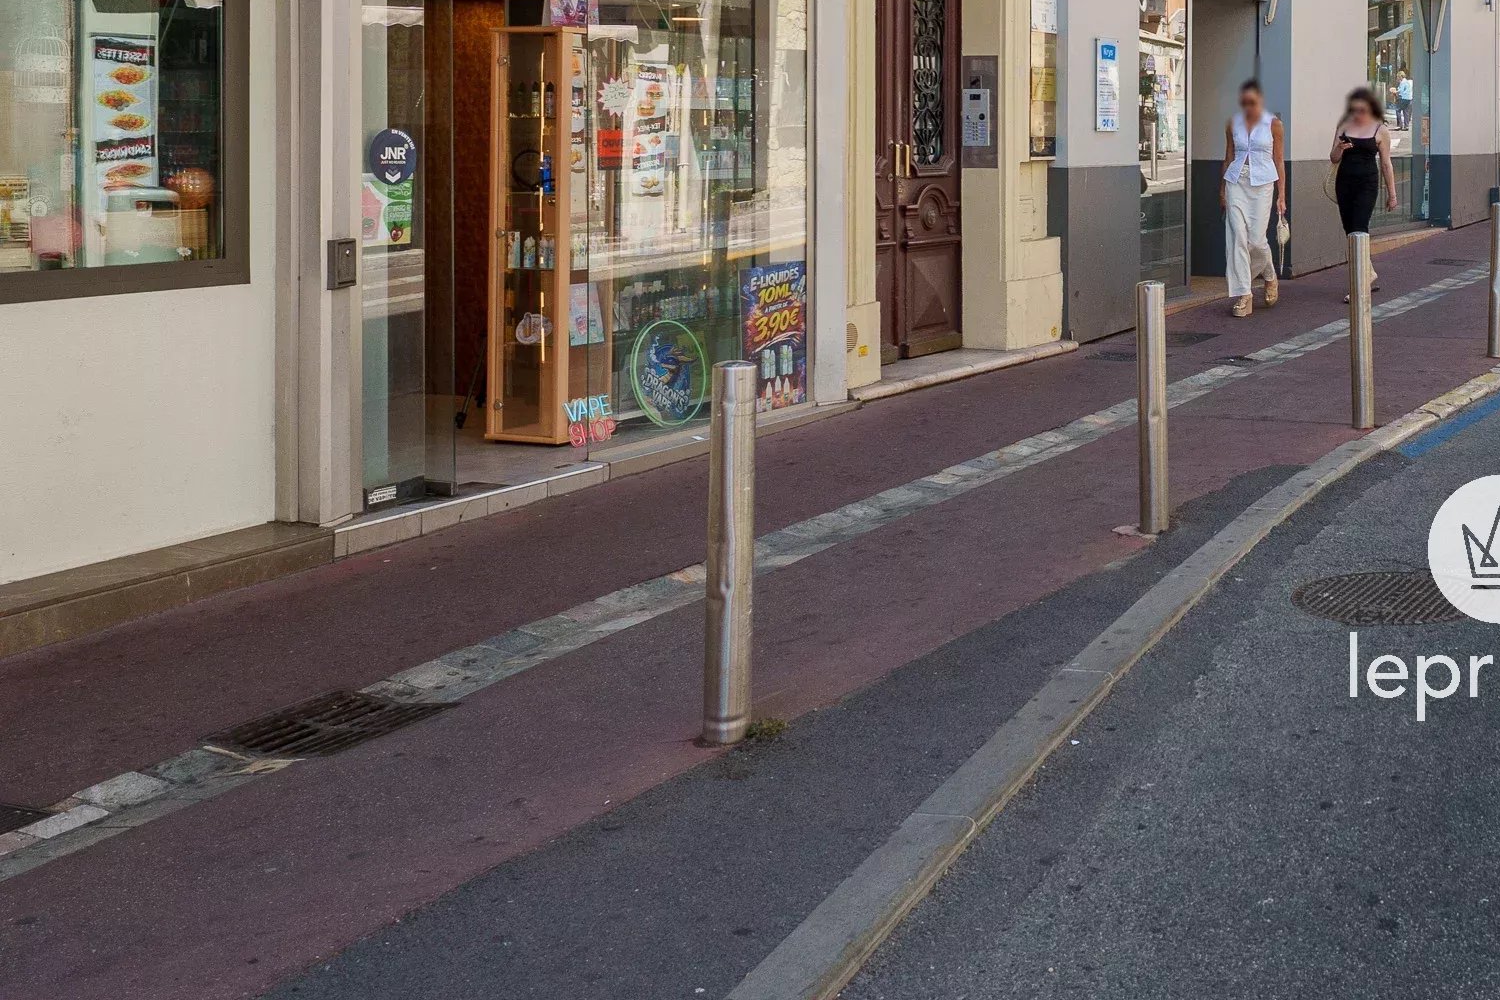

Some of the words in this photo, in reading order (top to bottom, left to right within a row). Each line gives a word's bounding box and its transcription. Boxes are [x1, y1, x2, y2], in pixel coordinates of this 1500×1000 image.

[380, 146, 407, 160] JNR
[750, 266, 799, 292] E-LIQUIDES
[758, 283, 792, 308] 10ML
[753, 308, 799, 343] 3,90€
[563, 394, 613, 422] VAPE
[569, 417, 616, 448] SHOP
